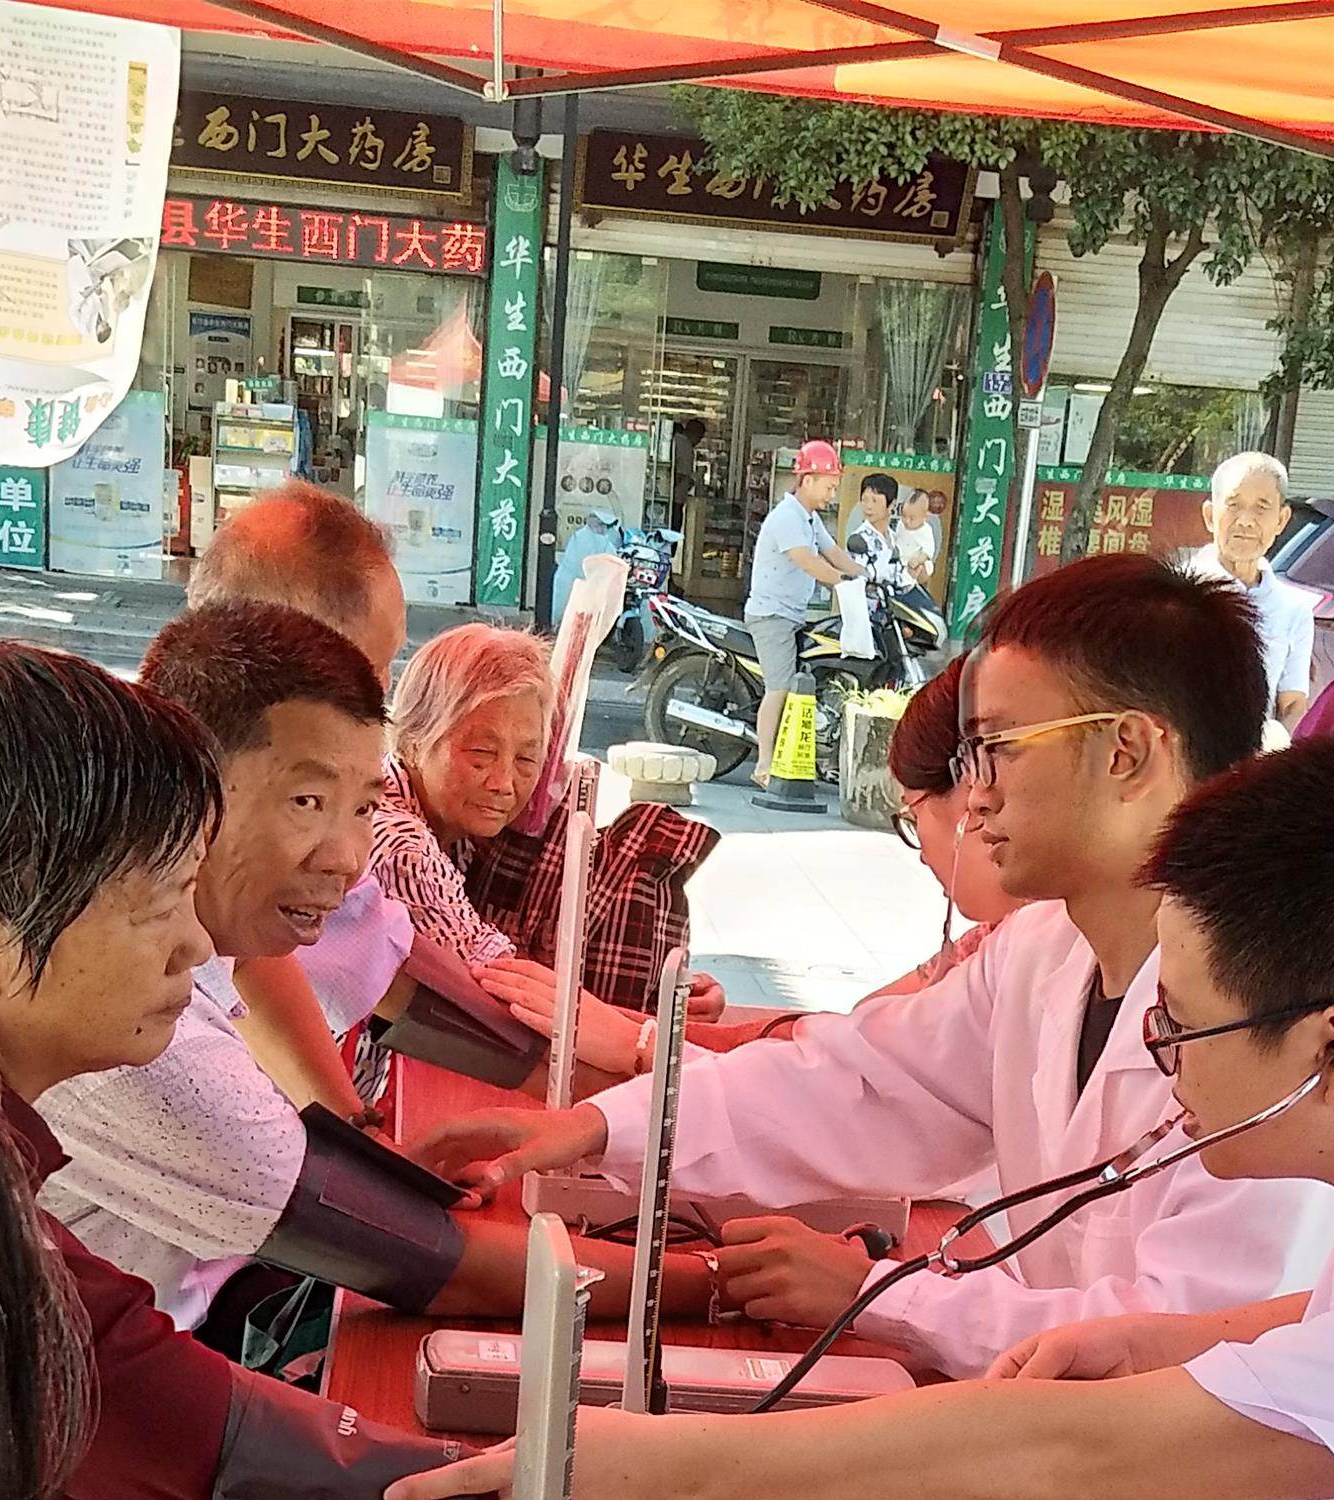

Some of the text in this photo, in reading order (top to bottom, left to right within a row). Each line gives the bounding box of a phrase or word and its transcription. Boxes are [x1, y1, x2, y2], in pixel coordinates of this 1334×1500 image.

[172, 105, 437, 174] 西门大药房
[611, 142, 938, 218] 华生西药房
[161, 200, 487, 272] 县华生西门大药
[483, 235, 534, 592] 华生西门大药房
[559, 428, 643, 447] 生西门大药房
[863, 454, 953, 473] 华生西门大药房
[1041, 490, 1066, 521] 湿
